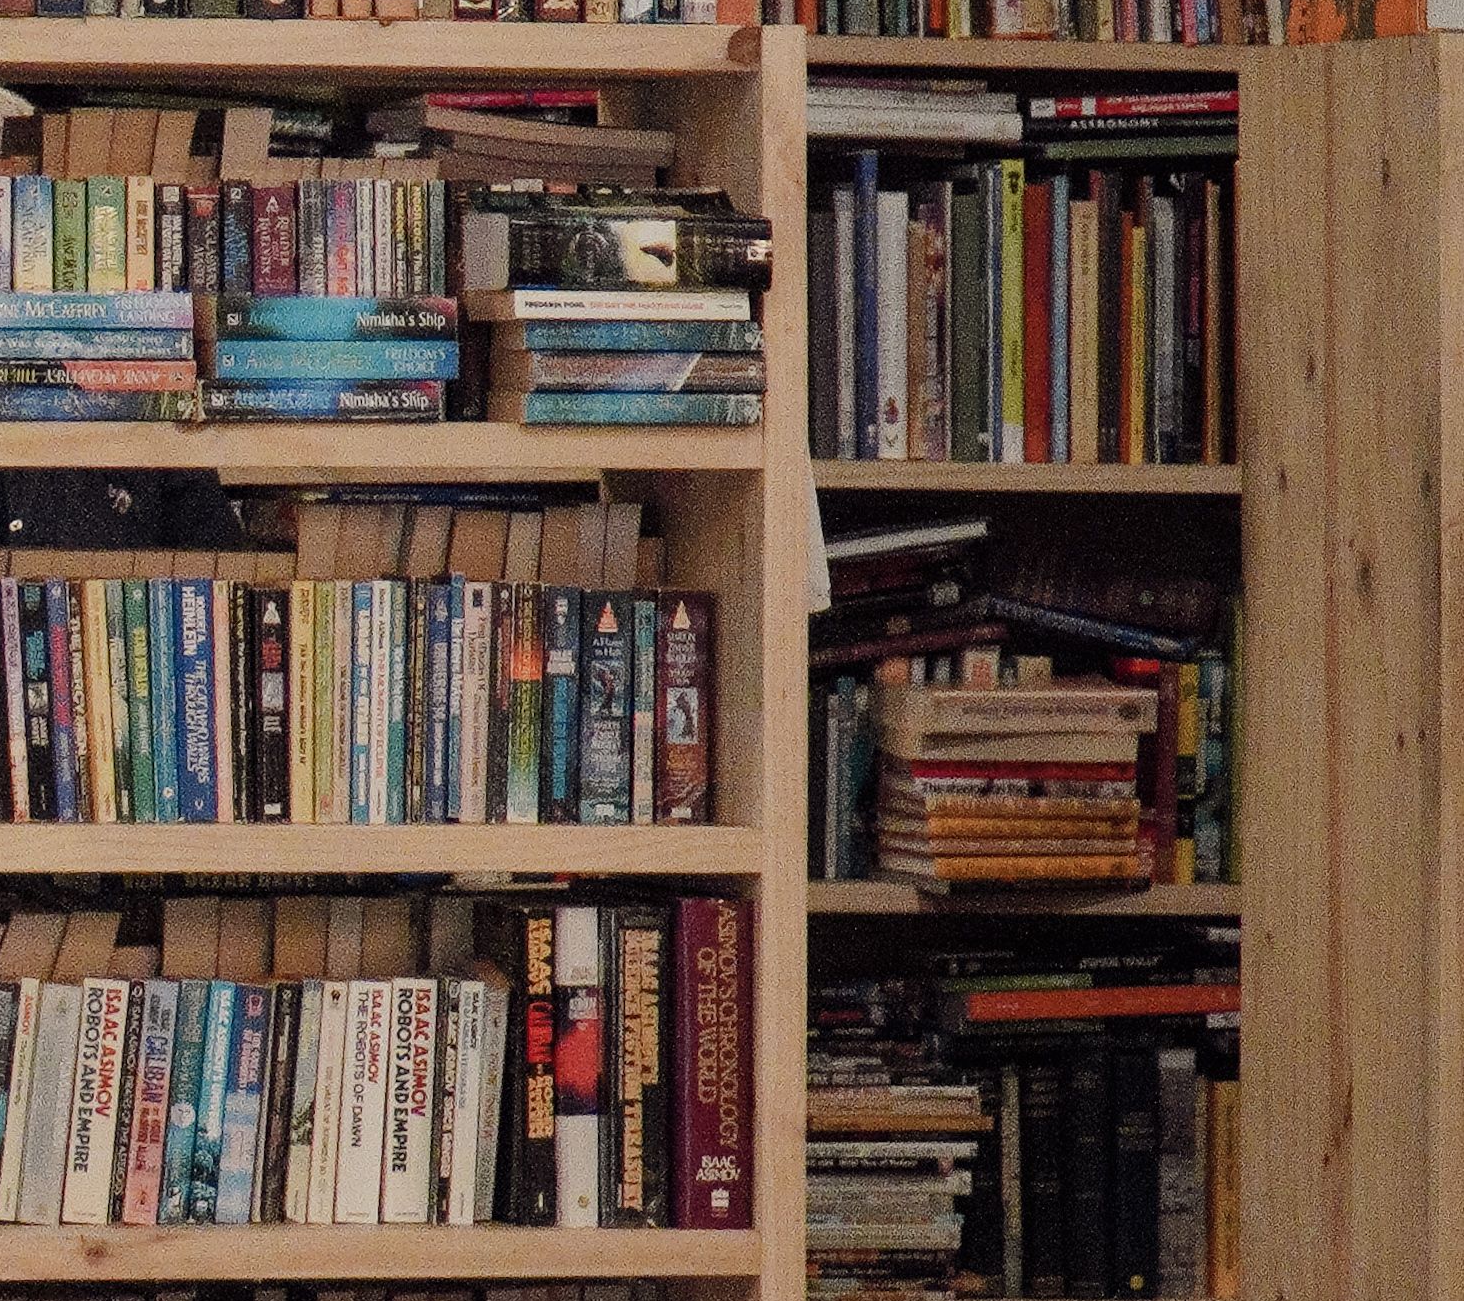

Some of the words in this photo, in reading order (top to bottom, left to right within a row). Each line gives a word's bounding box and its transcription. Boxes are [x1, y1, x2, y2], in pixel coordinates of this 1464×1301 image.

[356, 311, 416, 331] Nimisha's
[419, 311, 446, 332] Ship
[181, 587, 199, 657] HEINLEIN
[392, 988, 414, 1060] ROBOTS
[413, 988, 432, 1037] ISAAC
[392, 1065, 411, 1103] AND
[411, 1044, 429, 1118] ASIMOV
[391, 1107, 409, 1172] EMPIRE
